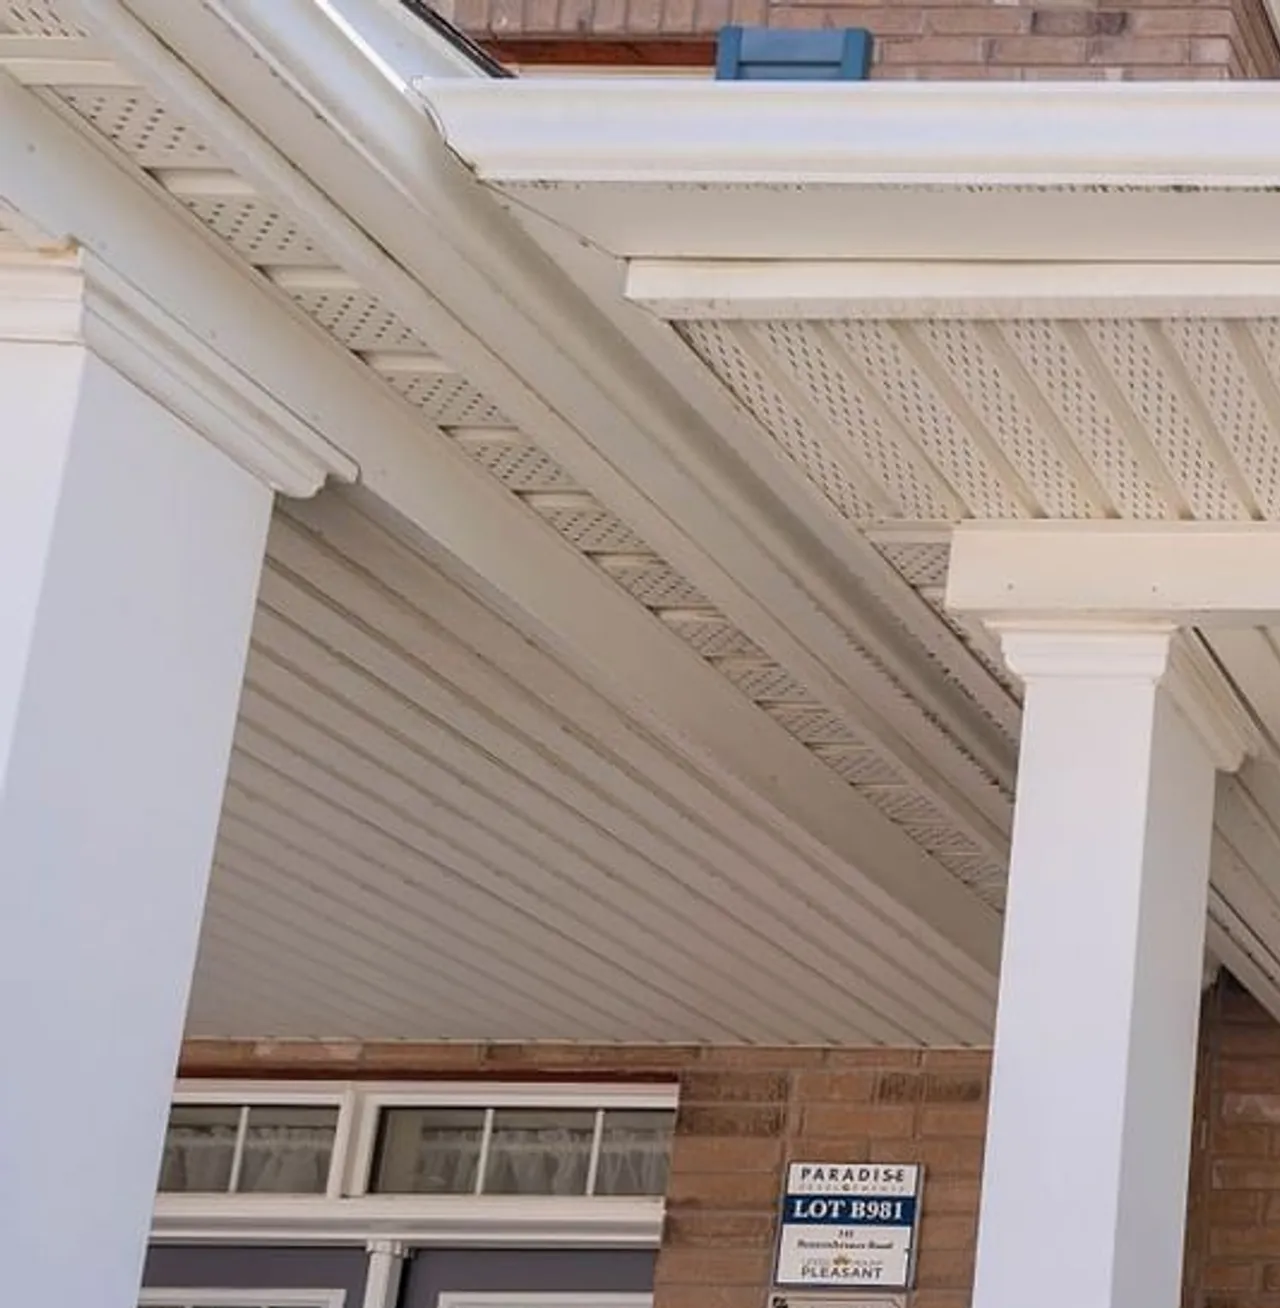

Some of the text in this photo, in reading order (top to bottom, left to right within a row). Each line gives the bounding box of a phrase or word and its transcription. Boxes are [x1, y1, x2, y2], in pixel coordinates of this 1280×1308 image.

[801, 1167, 905, 1182] PARADISE
[793, 1199, 904, 1219] LOT B981
[801, 1266, 883, 1279] PLEASANT
